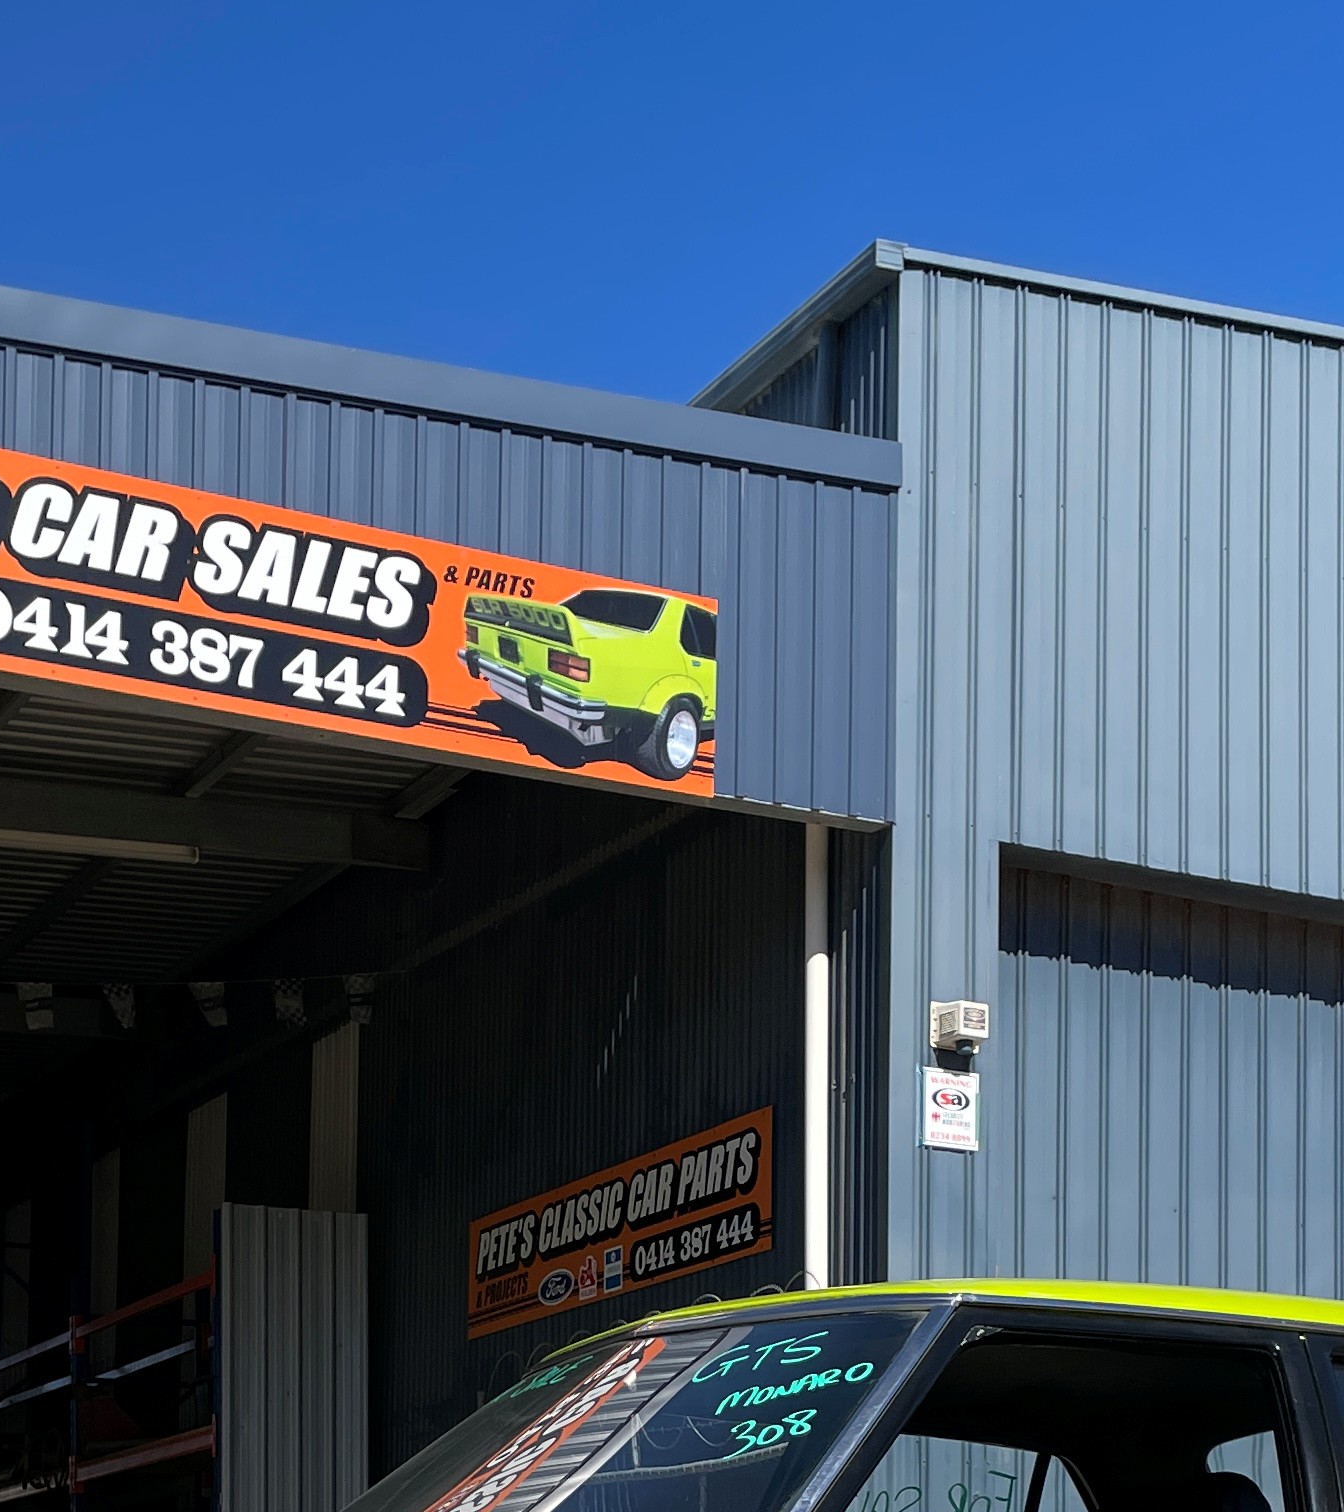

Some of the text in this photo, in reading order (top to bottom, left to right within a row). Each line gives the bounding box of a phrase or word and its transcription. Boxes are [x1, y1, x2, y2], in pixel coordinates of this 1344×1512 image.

[10, 483, 183, 581] CAR
[193, 517, 423, 631] SALES
[443, 565, 536, 599] & PARTS
[149, 621, 264, 690] 387
[282, 648, 406, 718] 444
[476, 1132, 757, 1275] PETE'S CLASSIC CAR PARTS
[634, 1210, 755, 1276] 0414 387 444
[485, 1271, 529, 1304] PROJECTS
[544, 1276, 568, 1299] Ford
[691, 1330, 830, 1384] GTS
[714, 1362, 874, 1416] MONARO
[722, 1408, 818, 1460] 308
